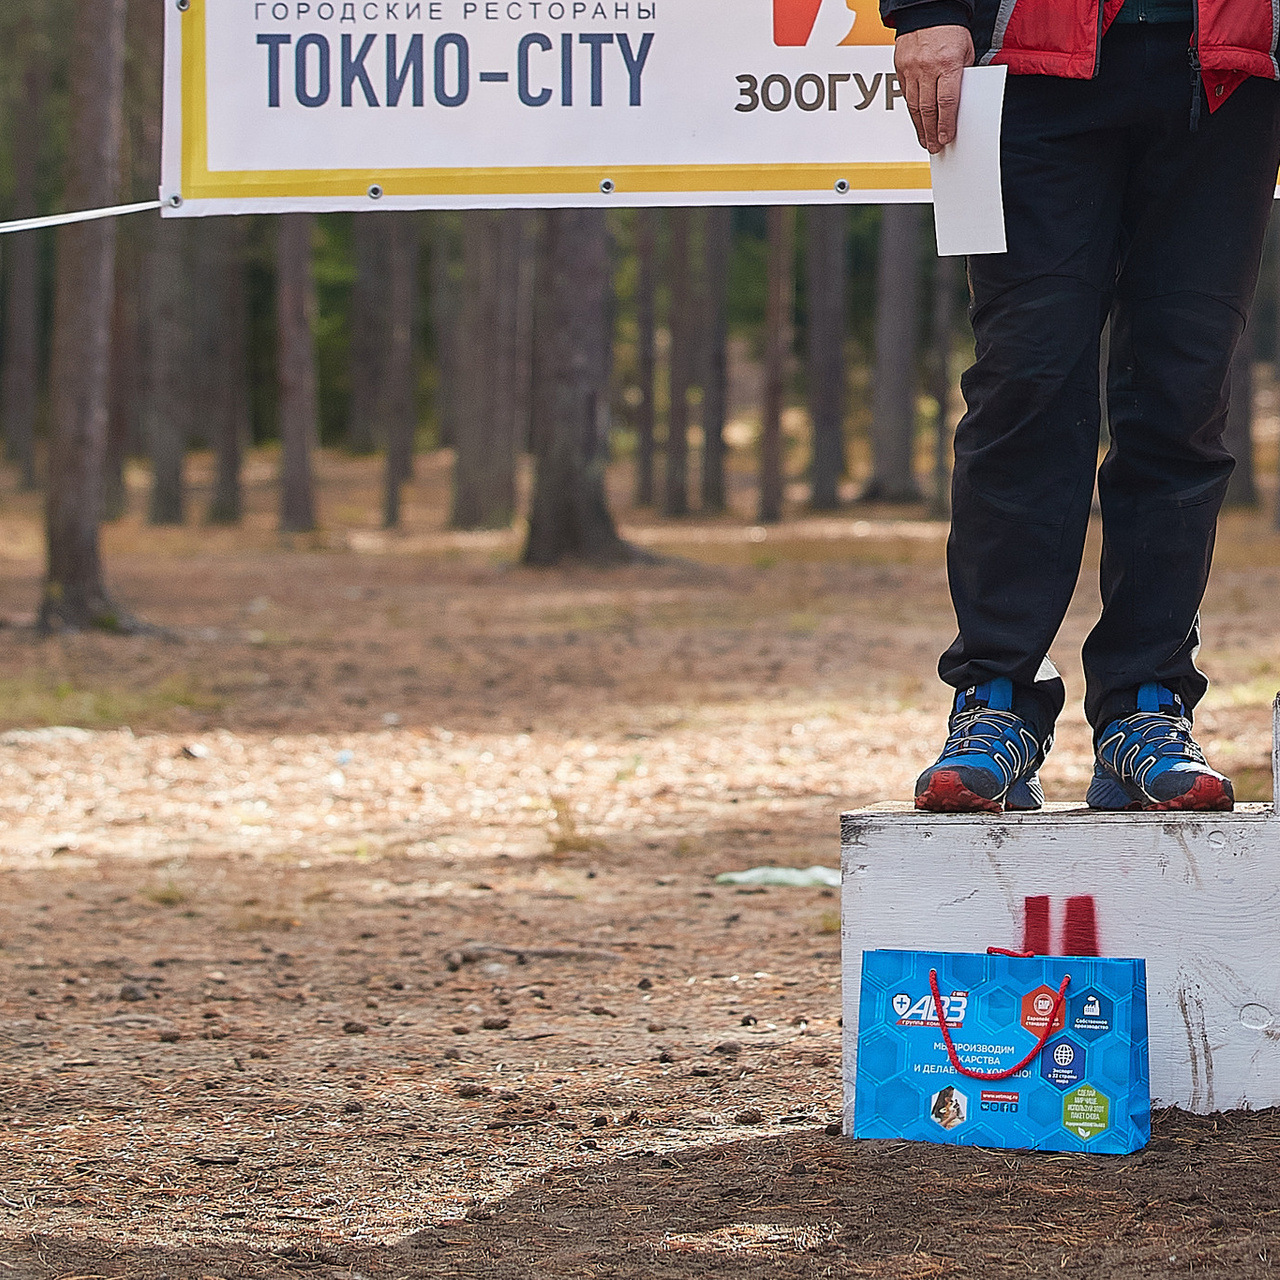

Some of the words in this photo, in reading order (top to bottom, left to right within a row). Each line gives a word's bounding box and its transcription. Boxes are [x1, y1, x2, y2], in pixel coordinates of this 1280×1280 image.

[254, 2, 442, 23] ГОРОДСКИЕ
[463, 2, 657, 20] РЕСТОРАНЫ
[256, 33, 656, 109] ТОКИО-CITY
[735, 73, 903, 112] ЗООГУР
[914, 1064, 920, 1072] И
